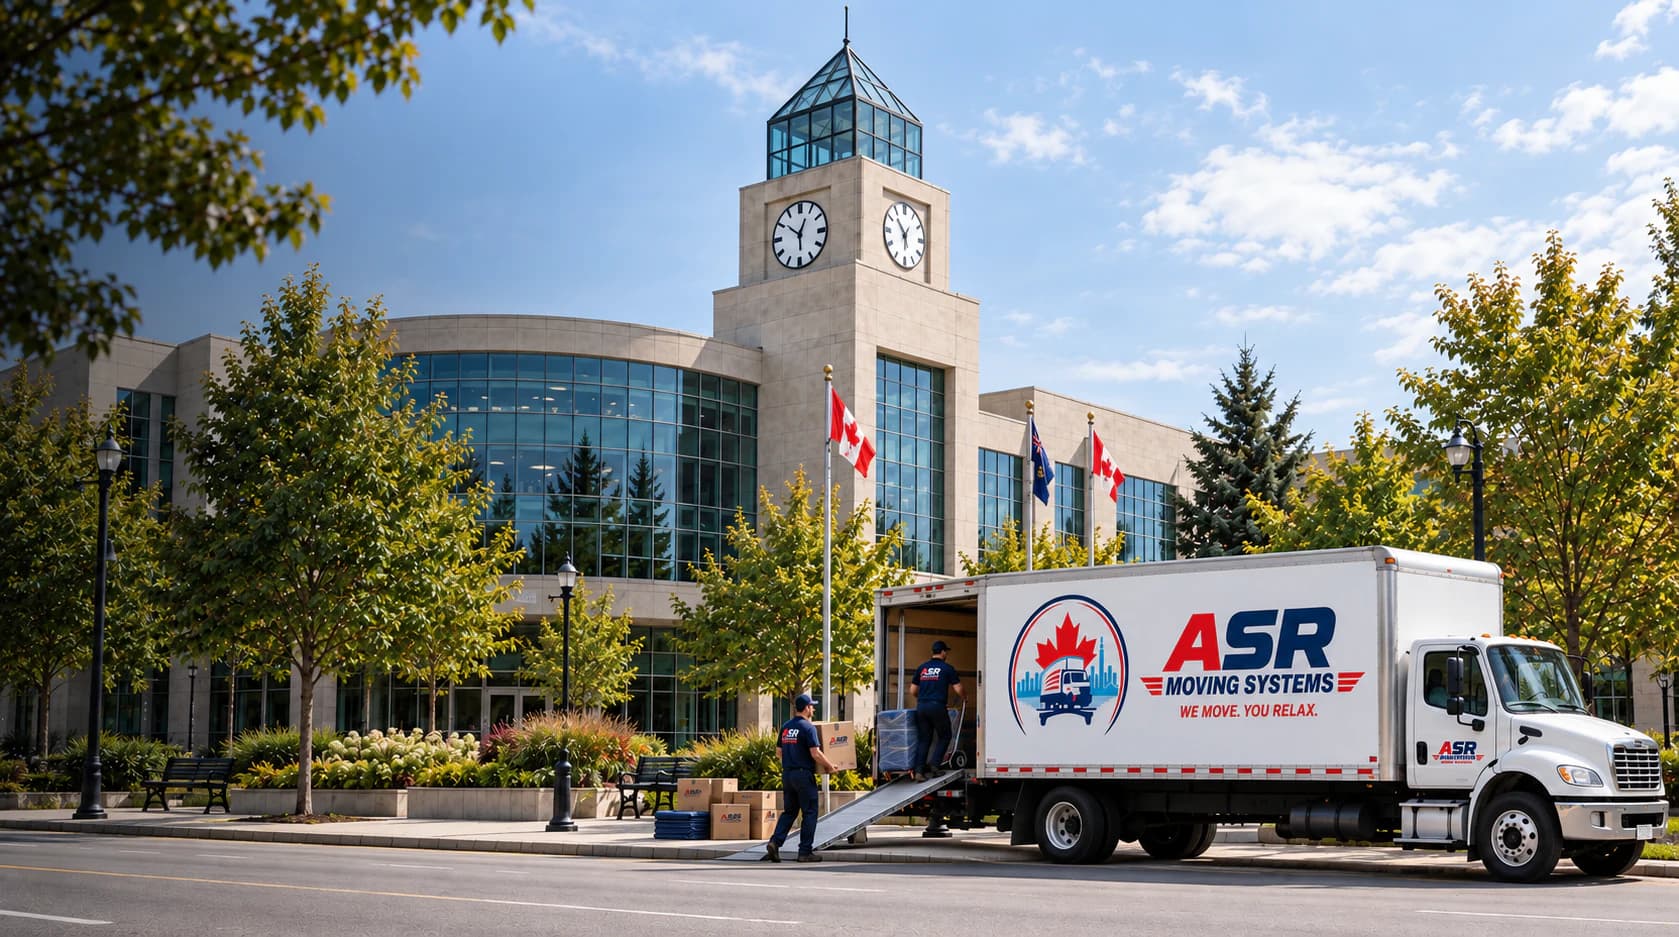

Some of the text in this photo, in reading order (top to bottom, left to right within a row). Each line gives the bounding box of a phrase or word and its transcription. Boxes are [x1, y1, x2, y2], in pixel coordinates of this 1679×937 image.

[1162, 606, 1337, 672] ASR
[1165, 672, 1335, 696] MOVING SYSTEMS
[1180, 703, 1318, 718] WE MOVE. YOU RELAX.
[1438, 741, 1477, 754] ASR
